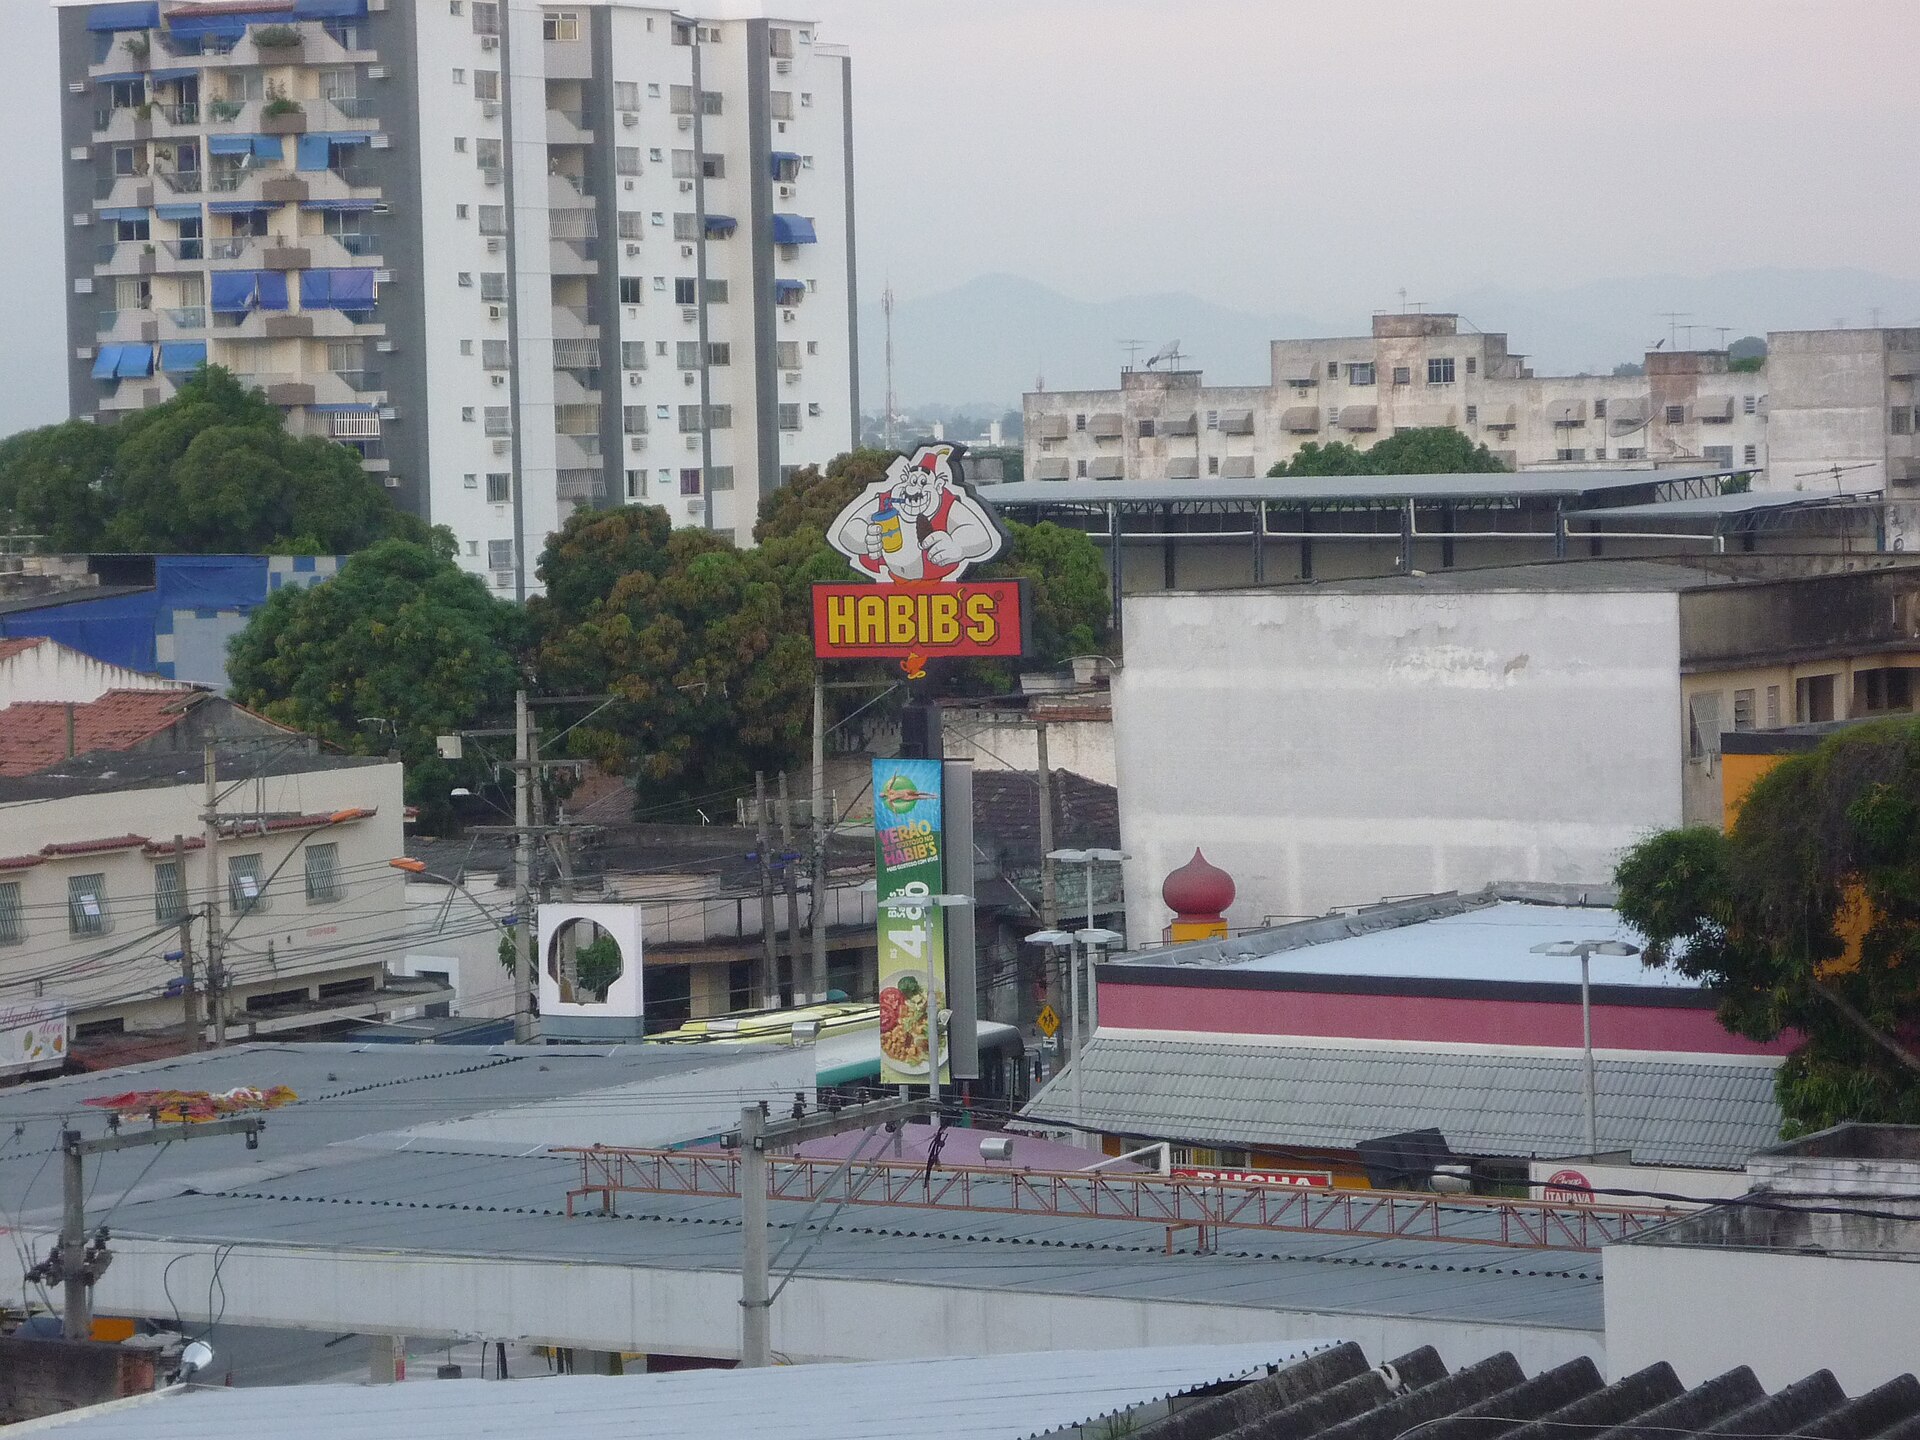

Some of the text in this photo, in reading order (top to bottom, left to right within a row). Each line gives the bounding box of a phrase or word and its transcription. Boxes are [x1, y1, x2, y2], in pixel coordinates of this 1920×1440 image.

[827, 587, 999, 647] HABIB'S
[879, 819, 931, 845] VERÃO
[884, 842, 937, 865] HABIB'S
[896, 888, 906, 918] Sad
[1545, 1191, 1591, 1204] ITAIPAVA
